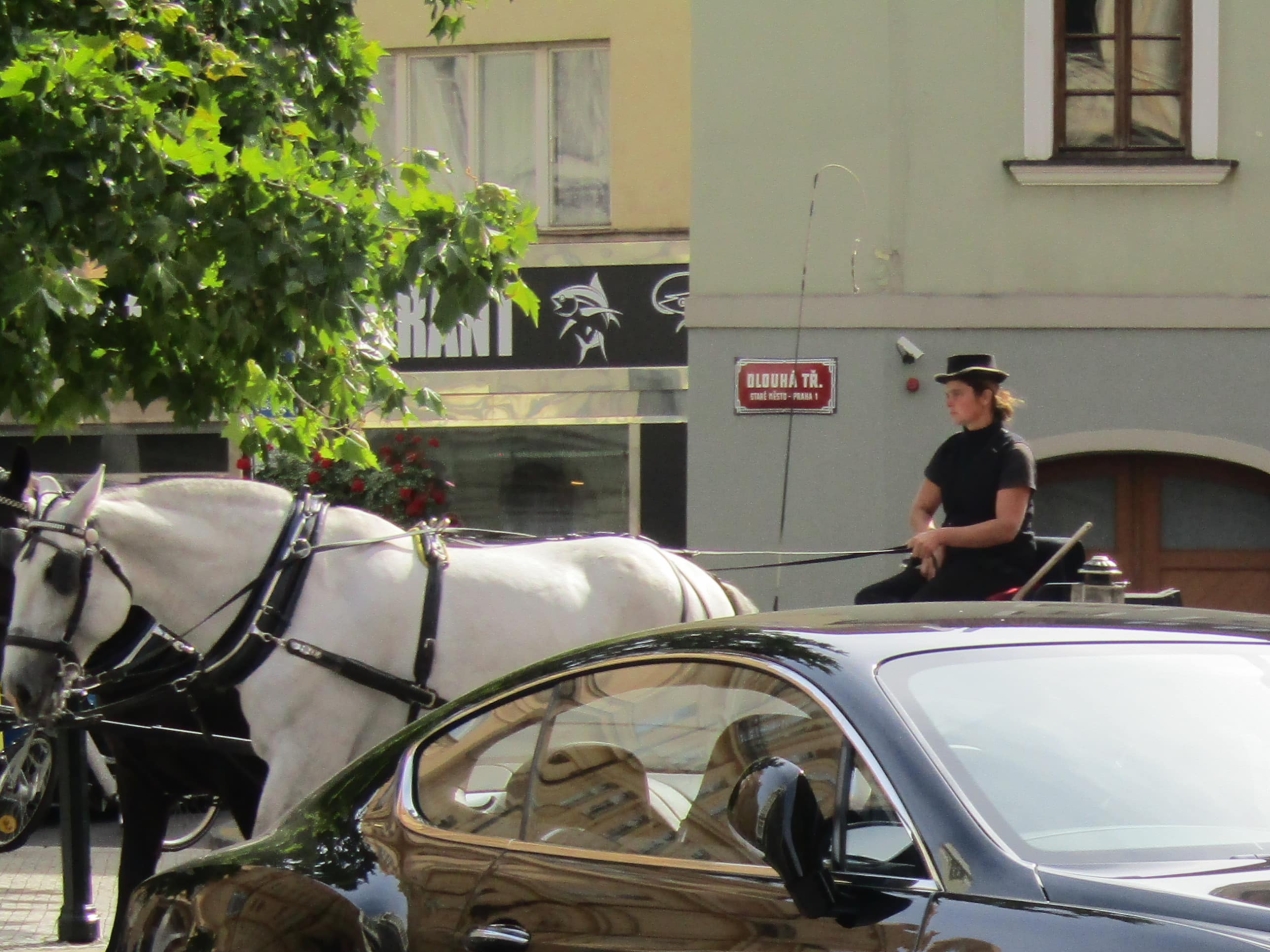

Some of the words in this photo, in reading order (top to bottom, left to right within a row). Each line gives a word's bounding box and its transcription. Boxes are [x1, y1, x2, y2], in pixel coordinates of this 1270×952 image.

[746, 370, 798, 388] DLOUHÁ
[802, 370, 823, 388] TŘ.
[793, 392, 812, 400] PRAHA
